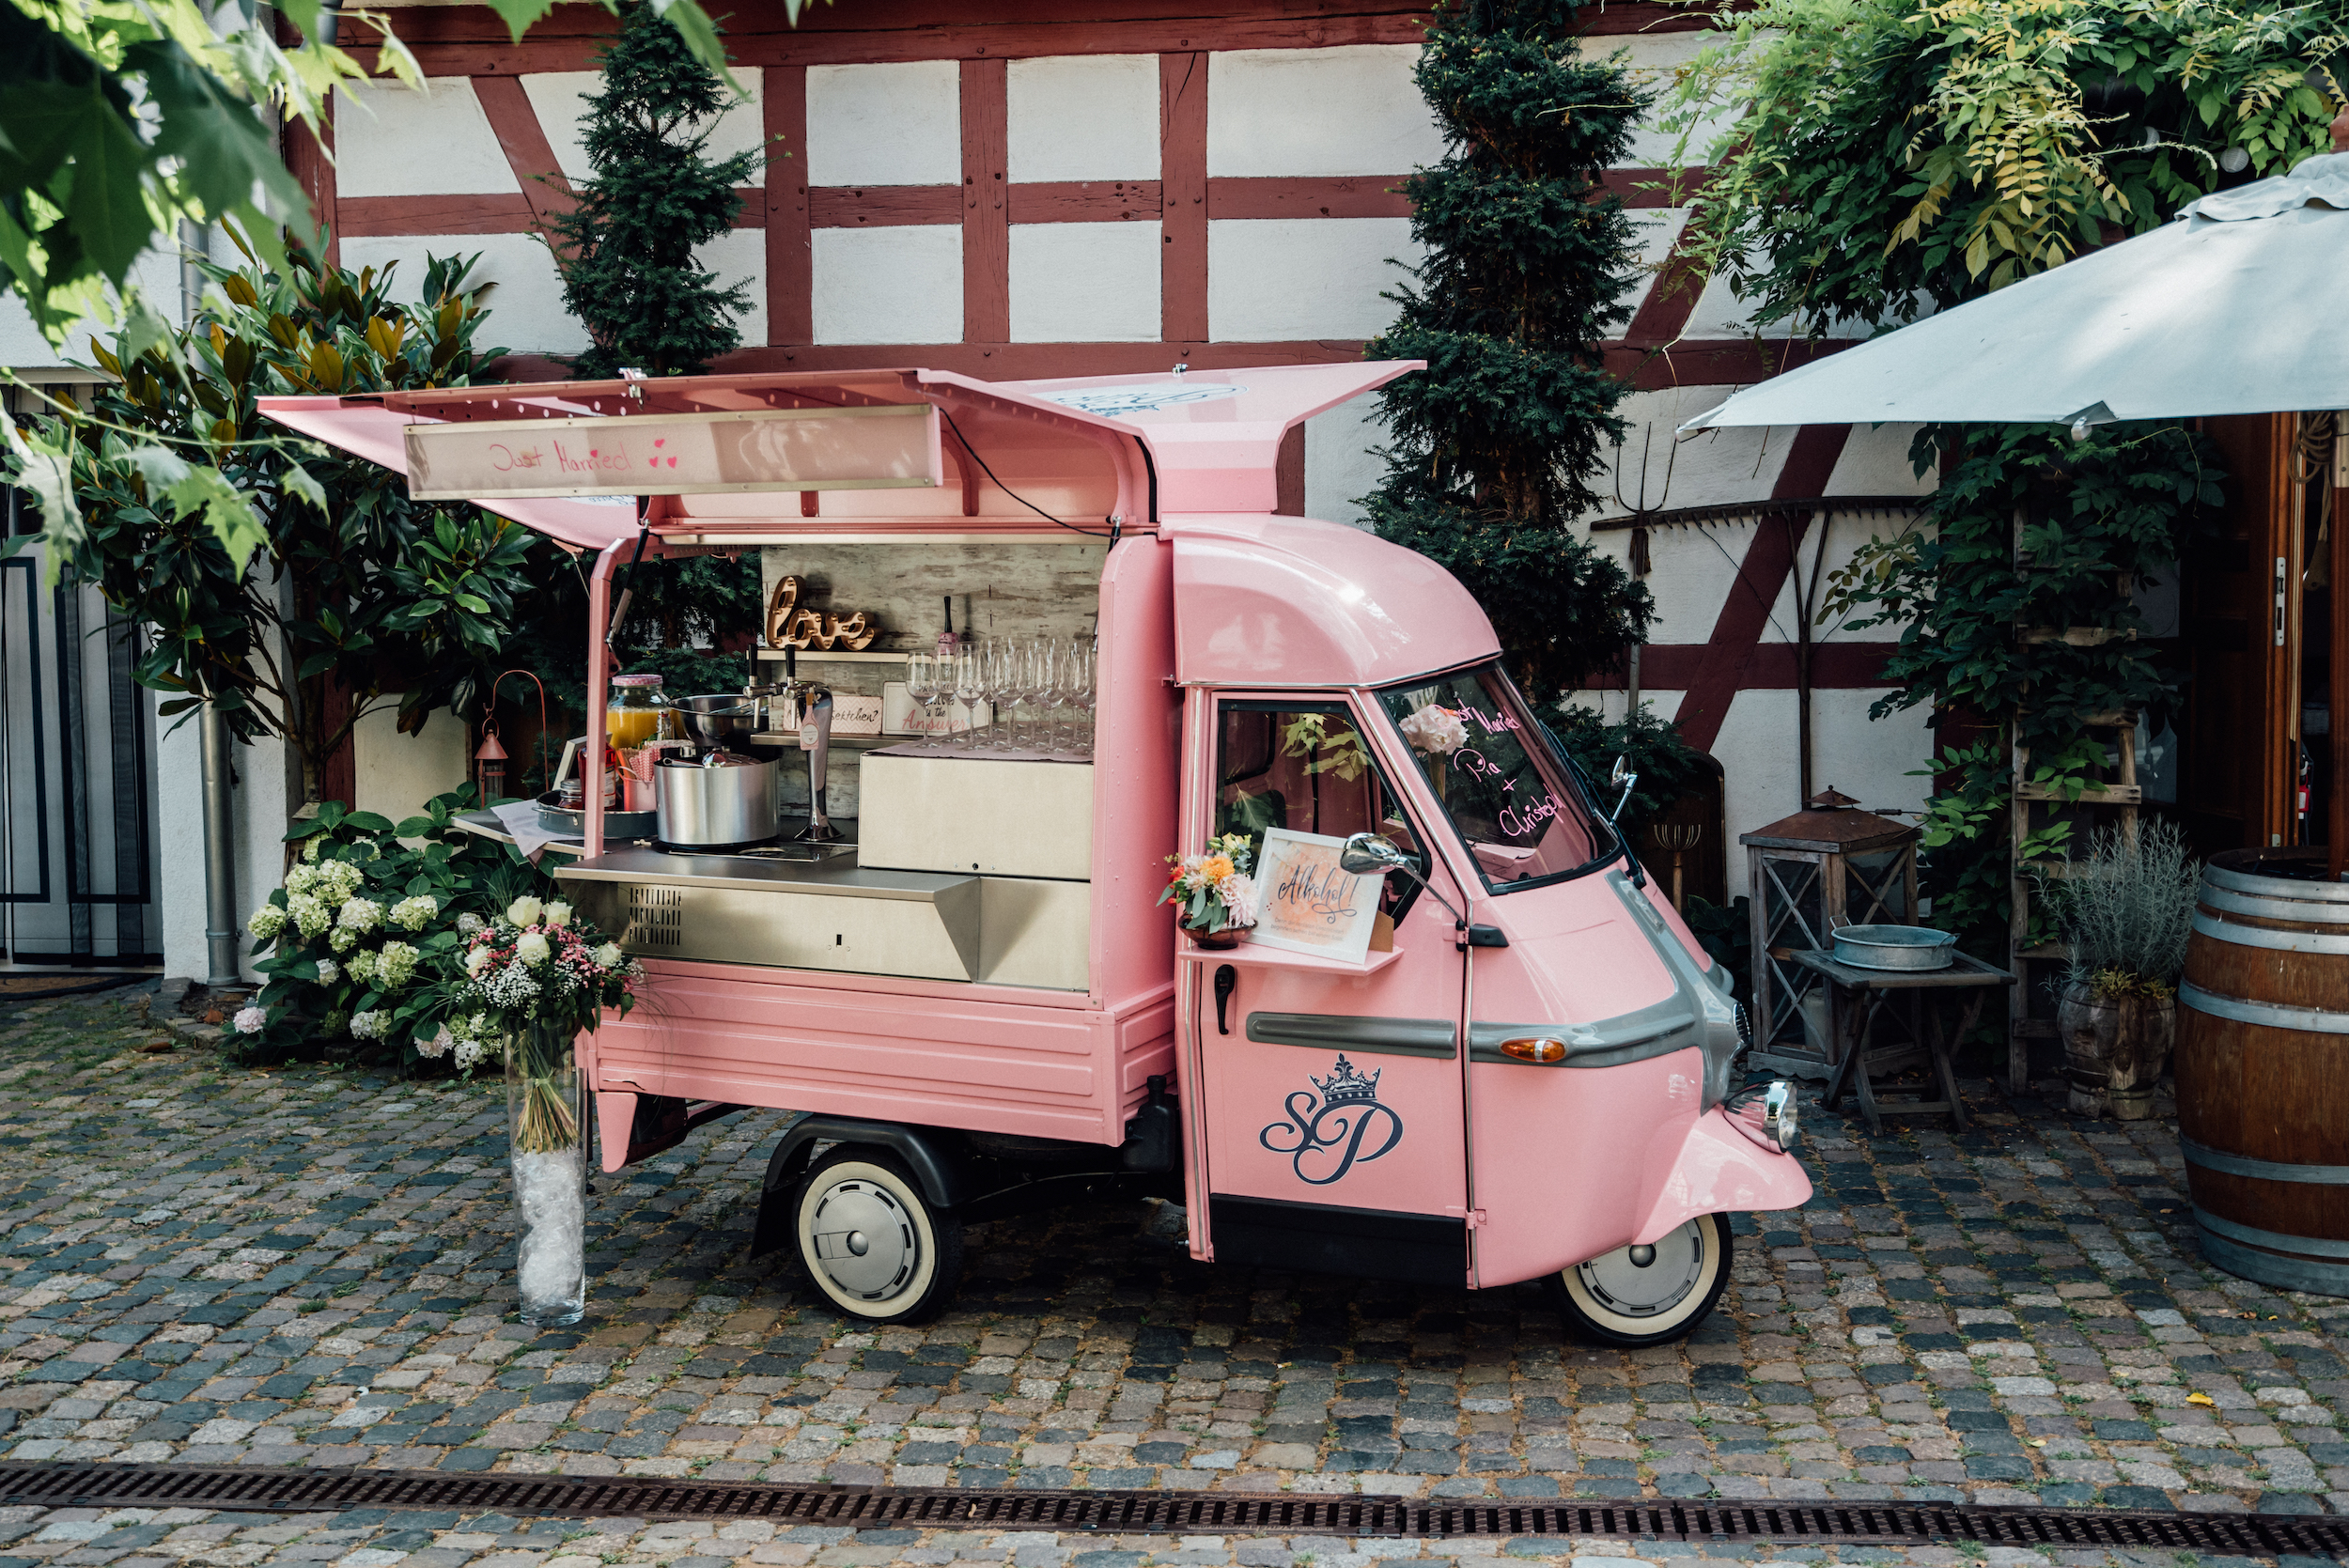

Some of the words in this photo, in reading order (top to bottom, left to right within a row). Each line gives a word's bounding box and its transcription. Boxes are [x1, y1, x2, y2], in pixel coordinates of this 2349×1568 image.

[490, 443, 543, 472] Just
[552, 440, 632, 473] Married
[902, 708, 969, 731] Answer
[935, 706, 947, 718] the
[1470, 706, 1521, 735] Married
[1454, 748, 1502, 783] Pia
[1499, 783, 1567, 837] Christoph
[1278, 863, 1361, 924] Alkohol!
